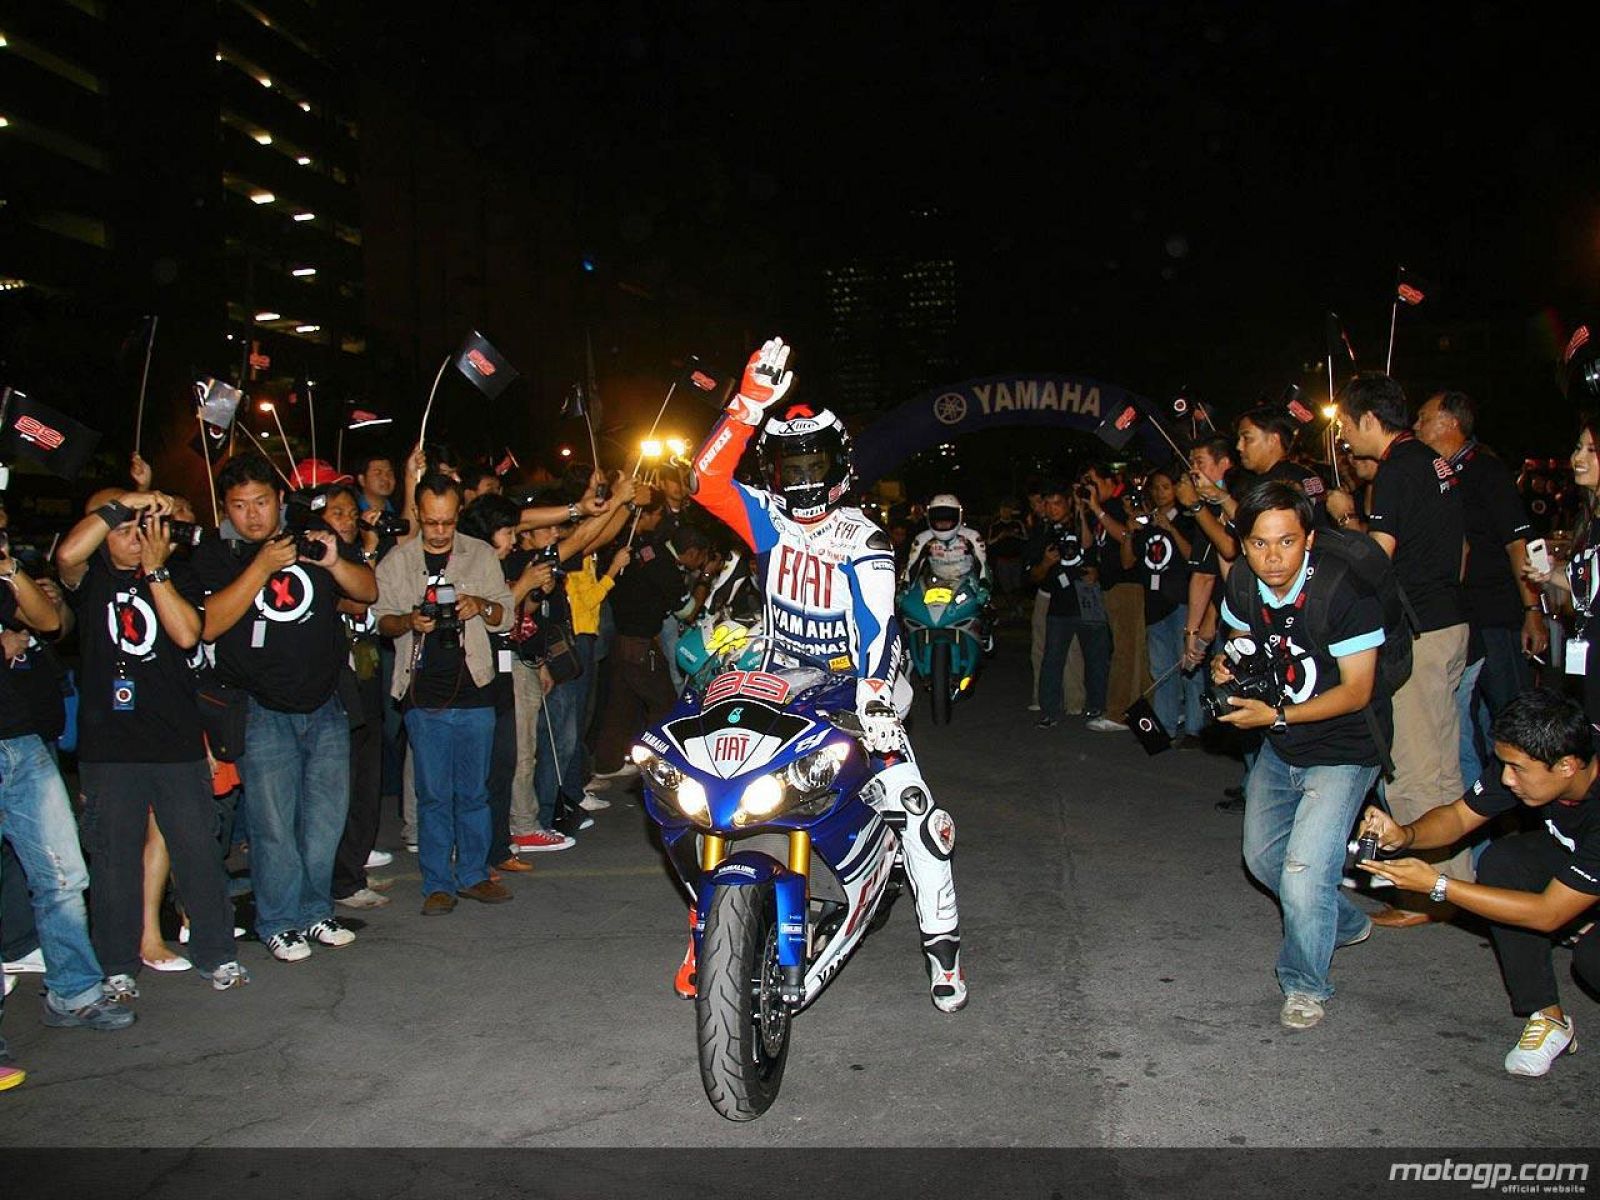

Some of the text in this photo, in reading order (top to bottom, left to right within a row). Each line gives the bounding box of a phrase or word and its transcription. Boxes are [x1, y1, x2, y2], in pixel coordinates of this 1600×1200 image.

[971, 380, 1101, 418] YAMAHA
[834, 520, 862, 540] FIAT
[777, 544, 835, 609] FIAT
[772, 604, 847, 639] YAMAHA
[703, 670, 791, 706] 99
[640, 731, 670, 755] YAMAHA
[714, 736, 750, 762] FIAT
